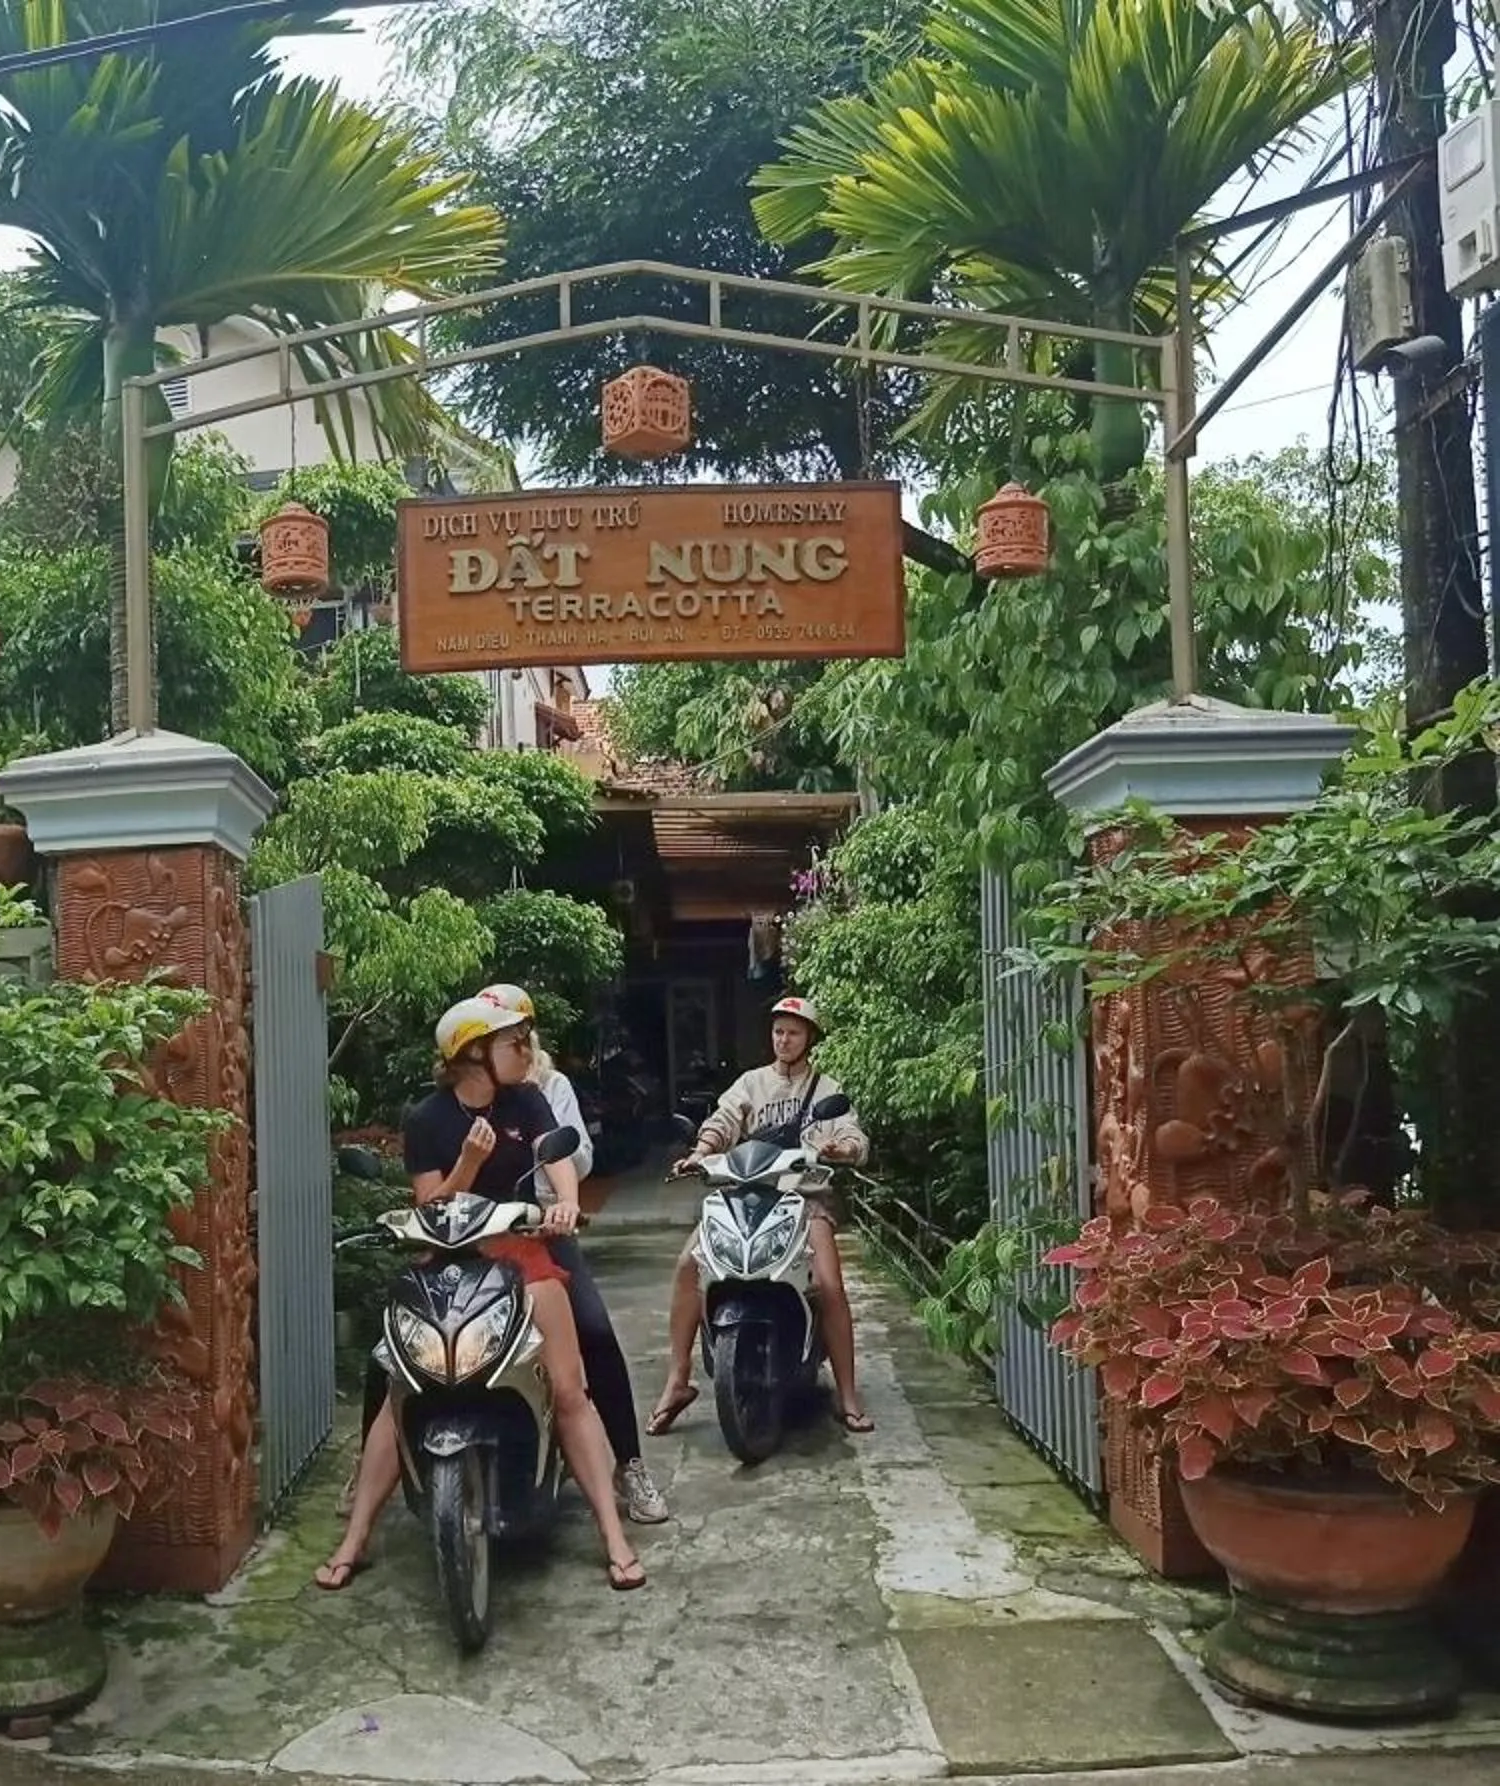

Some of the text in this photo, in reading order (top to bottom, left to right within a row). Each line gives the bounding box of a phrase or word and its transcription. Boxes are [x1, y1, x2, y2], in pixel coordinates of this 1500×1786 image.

[722, 500, 846, 523] HOMESTAY
[448, 532, 849, 593] ĐẤT NUNG
[507, 588, 785, 625] TERRACOTTA
